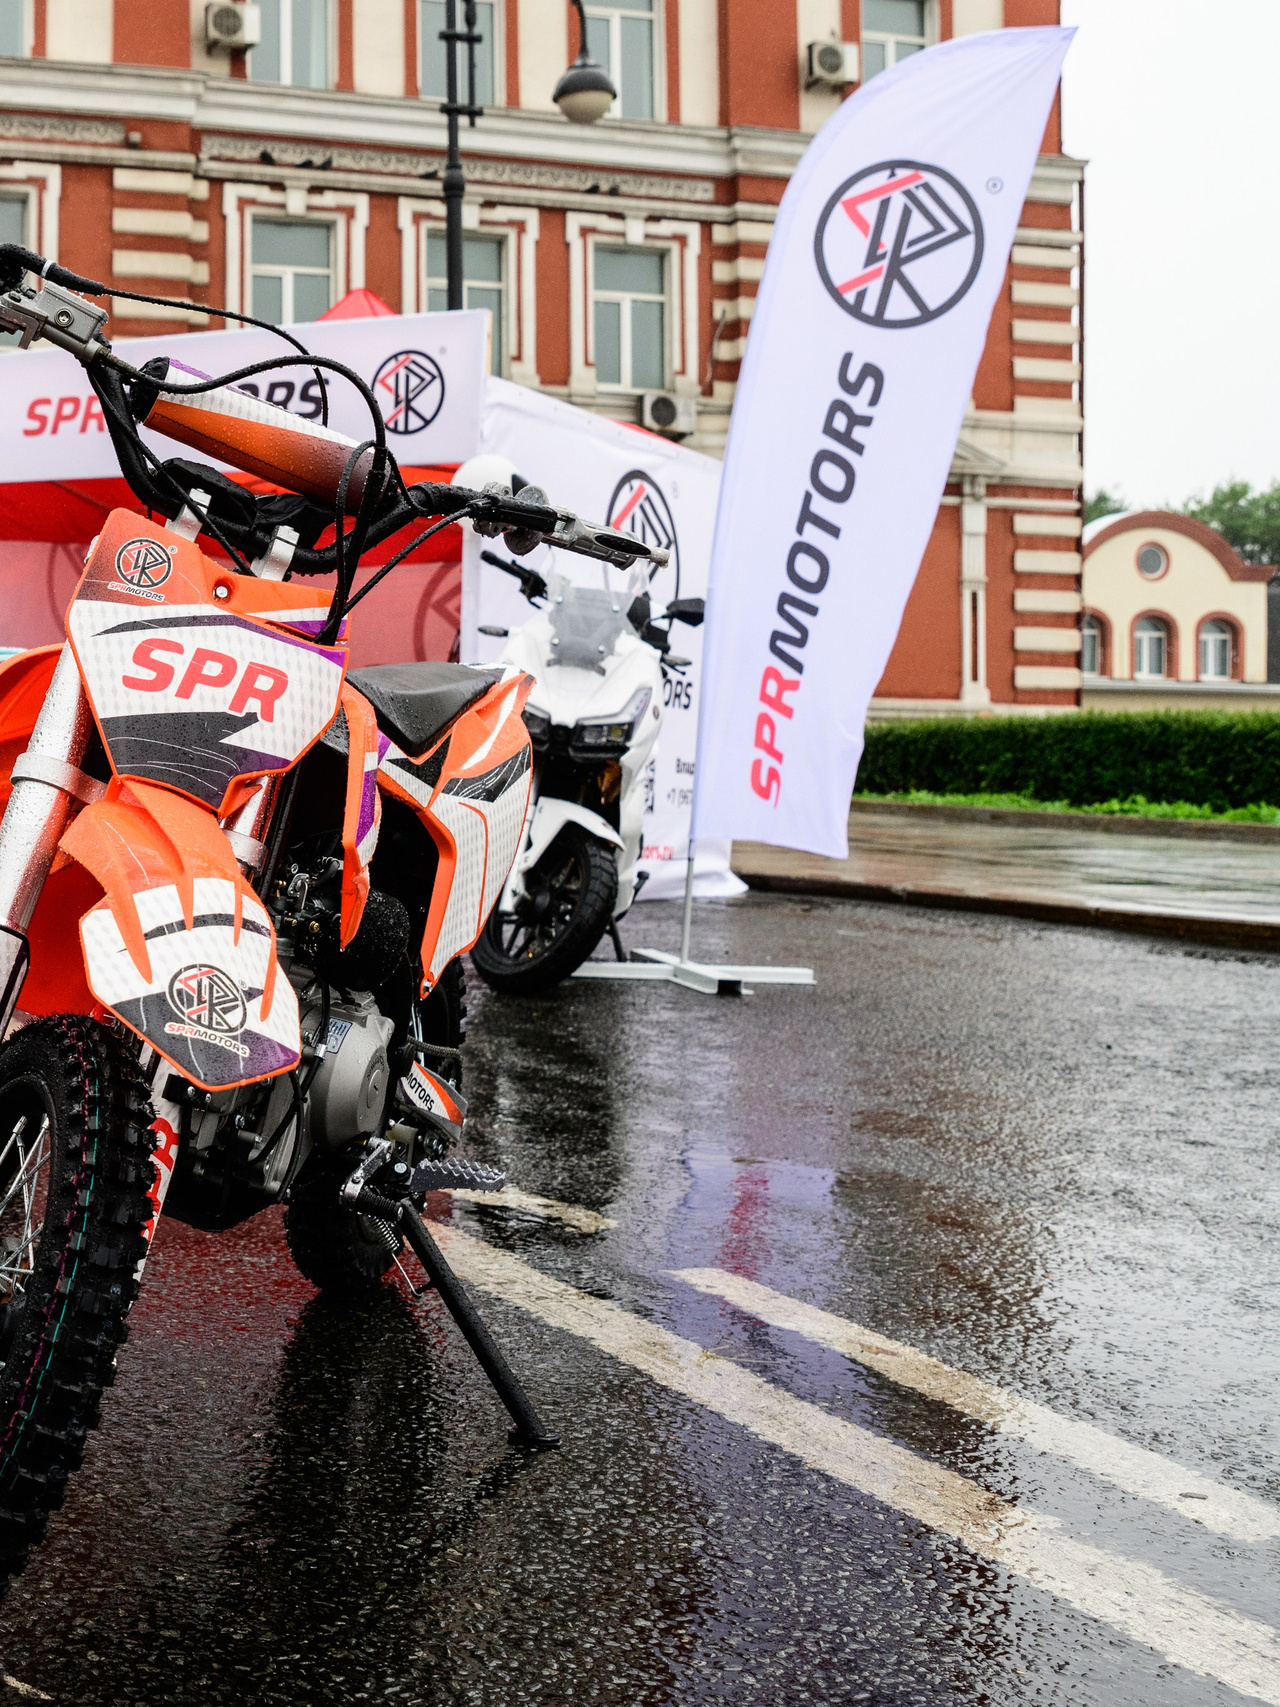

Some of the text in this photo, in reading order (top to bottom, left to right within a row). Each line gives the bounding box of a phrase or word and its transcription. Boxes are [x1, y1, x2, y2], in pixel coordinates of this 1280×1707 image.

[109, 582, 163, 601] SPRMOTORS
[751, 350, 885, 809] SPRMOTORS
[122, 638, 289, 723] SPR
[167, 1023, 248, 1056] SPRMOTORS
